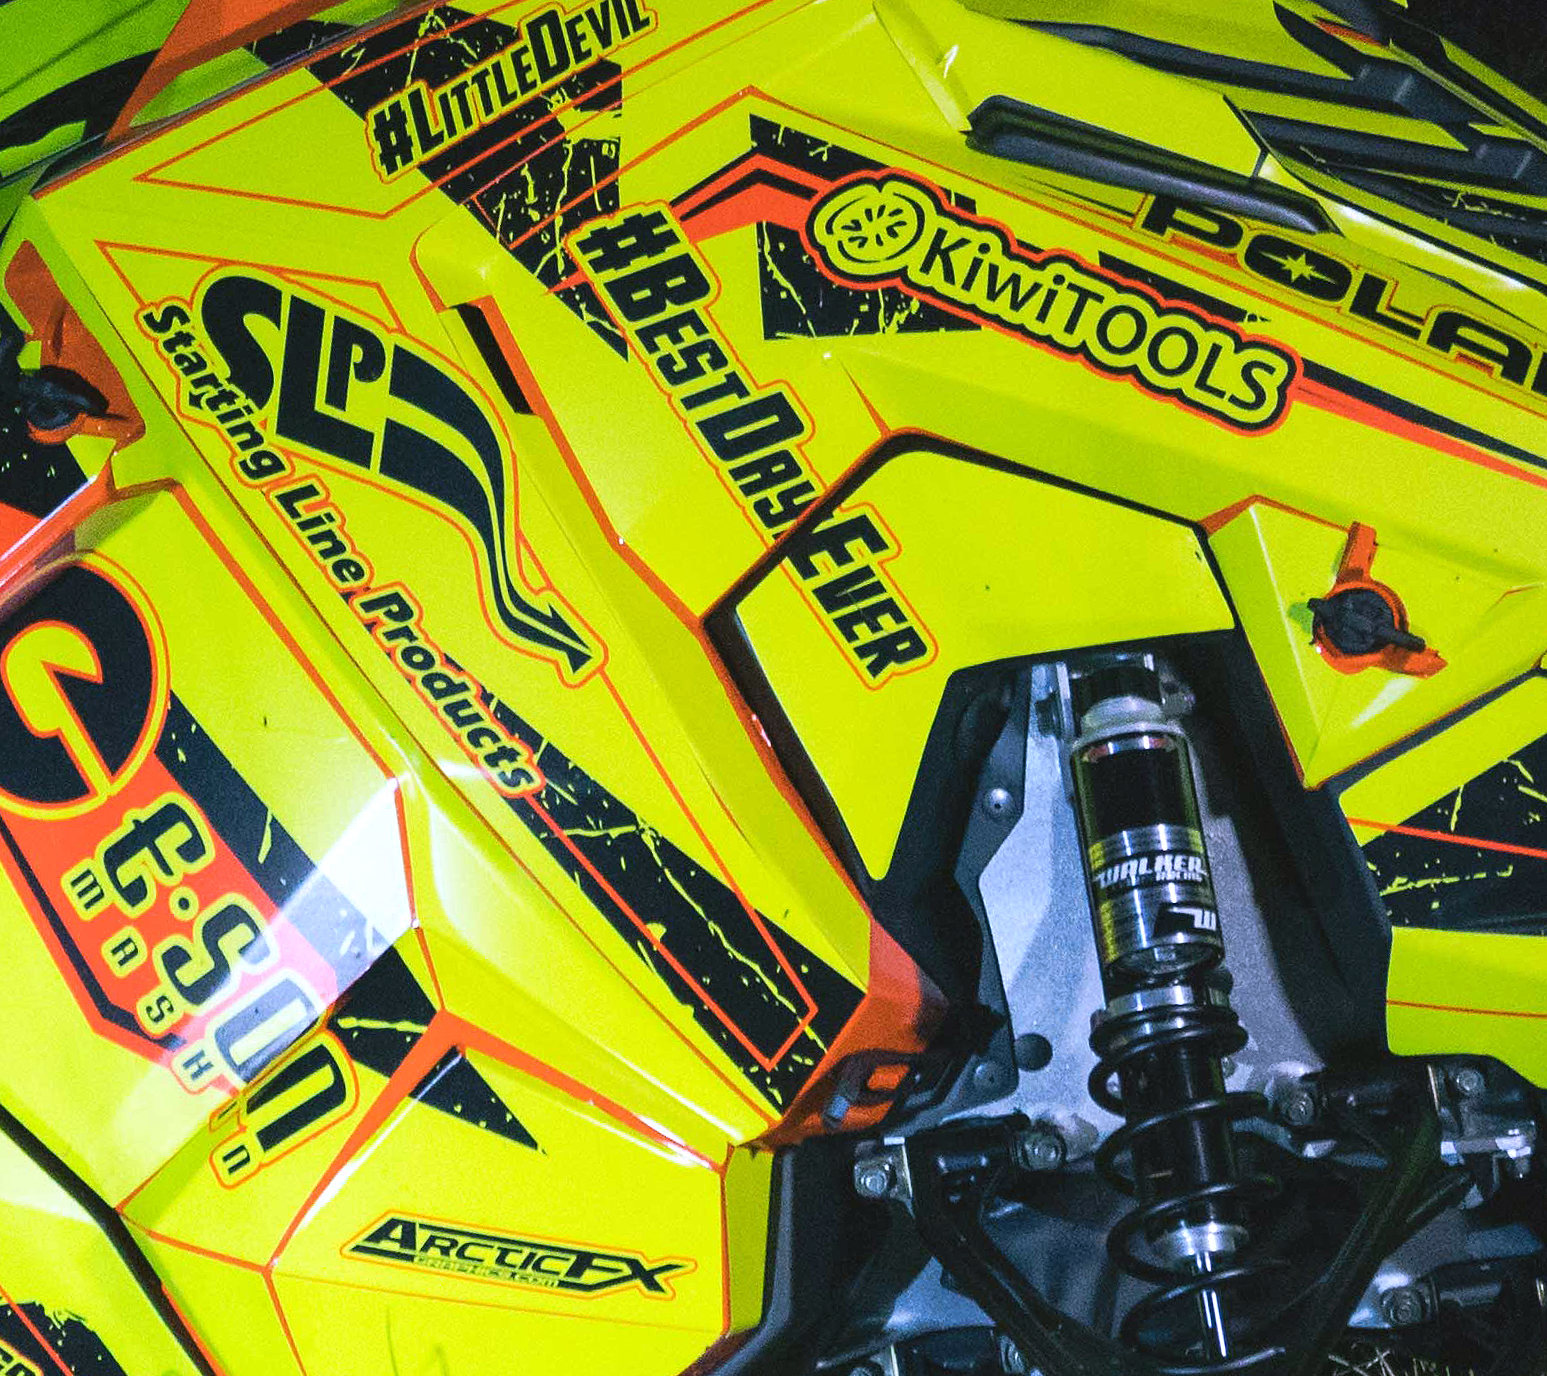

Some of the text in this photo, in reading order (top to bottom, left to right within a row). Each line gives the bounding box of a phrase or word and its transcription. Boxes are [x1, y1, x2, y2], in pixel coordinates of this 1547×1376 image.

[143, 303, 539, 794] Starting Line Products
